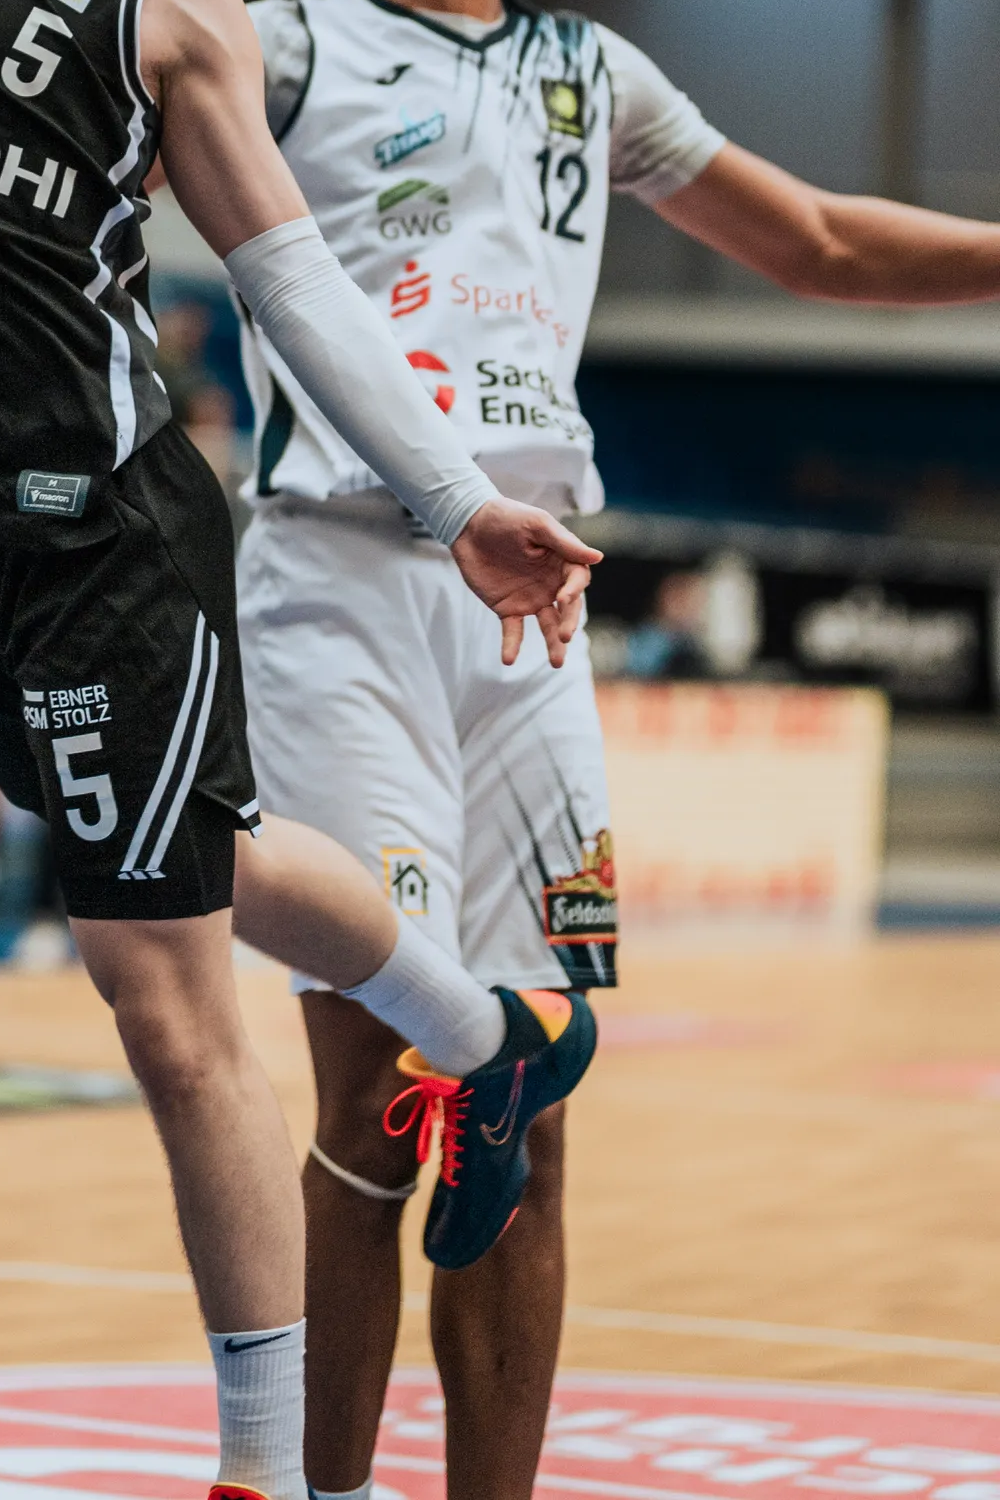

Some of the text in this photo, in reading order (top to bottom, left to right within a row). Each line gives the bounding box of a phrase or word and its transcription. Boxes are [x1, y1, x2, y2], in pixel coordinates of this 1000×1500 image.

[1, 6, 73, 98] 5
[535, 145, 589, 243] 12
[379, 211, 451, 240] GWG
[39, 493, 70, 503] macron
[49, 684, 109, 708] EBNER
[52, 703, 112, 729] STOLZ
[52, 731, 119, 842] 5
